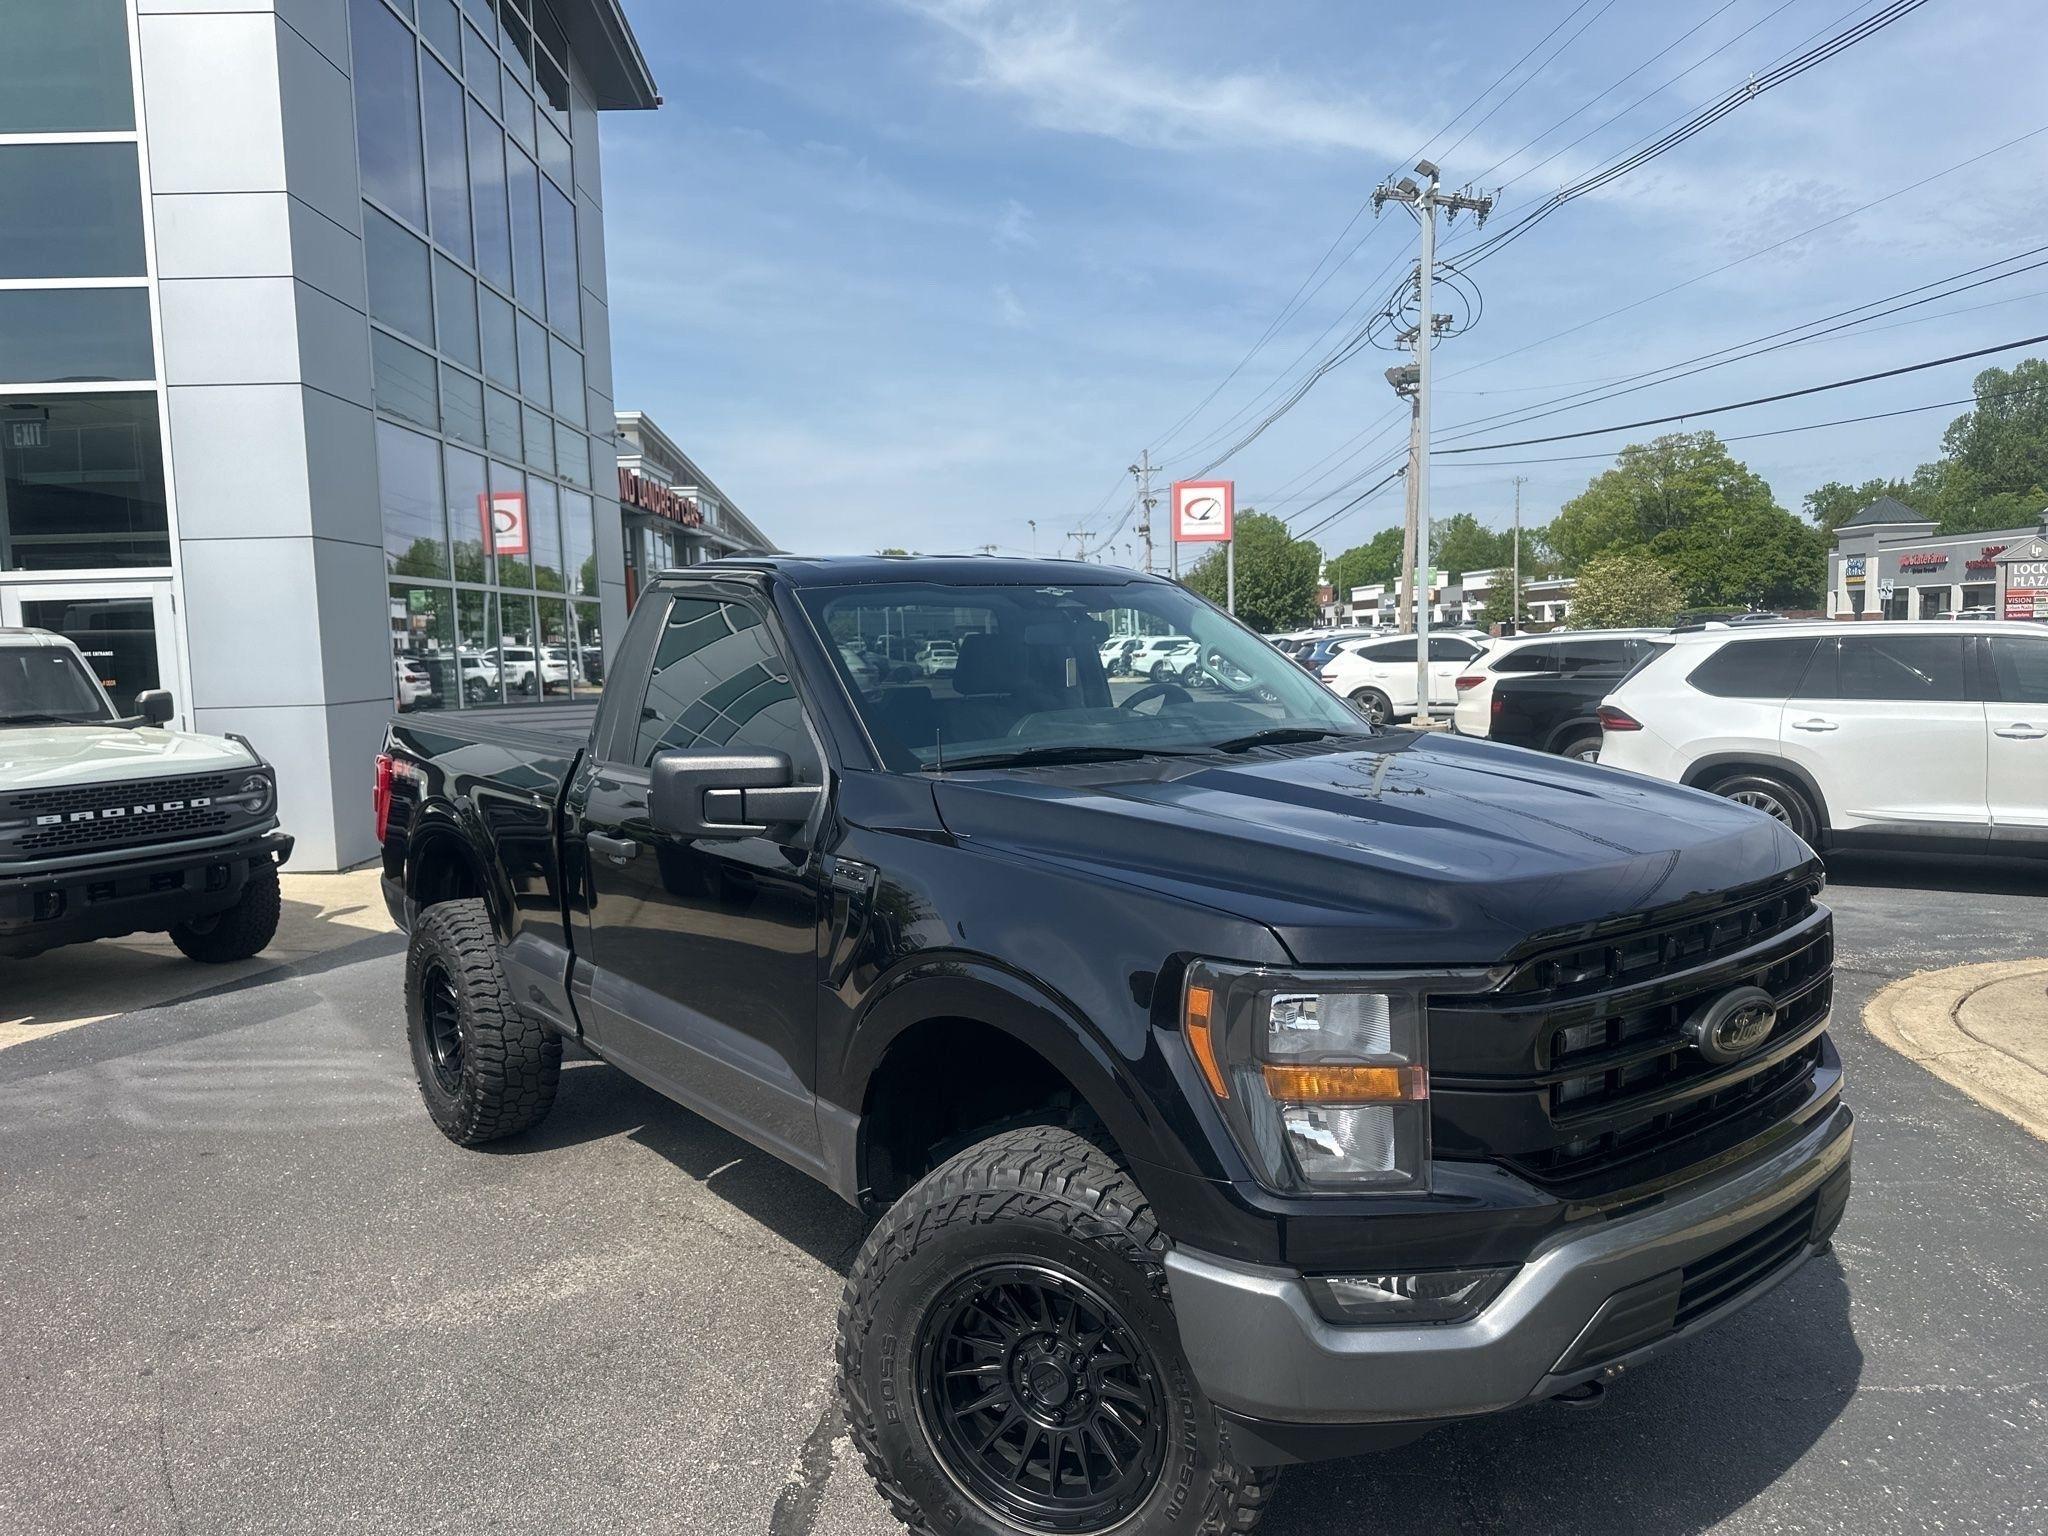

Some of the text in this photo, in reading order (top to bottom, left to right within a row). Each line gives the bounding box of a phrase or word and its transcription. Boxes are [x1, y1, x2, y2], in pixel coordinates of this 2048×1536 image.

[12, 423, 42, 446] EXIT
[636, 475, 681, 521] LANDRETH
[36, 797, 211, 826] BRONCO
[1731, 1011, 1766, 1044] Ford
[880, 1333, 901, 1425] BOSS
[1164, 1357, 1197, 1523] THOMPSON
